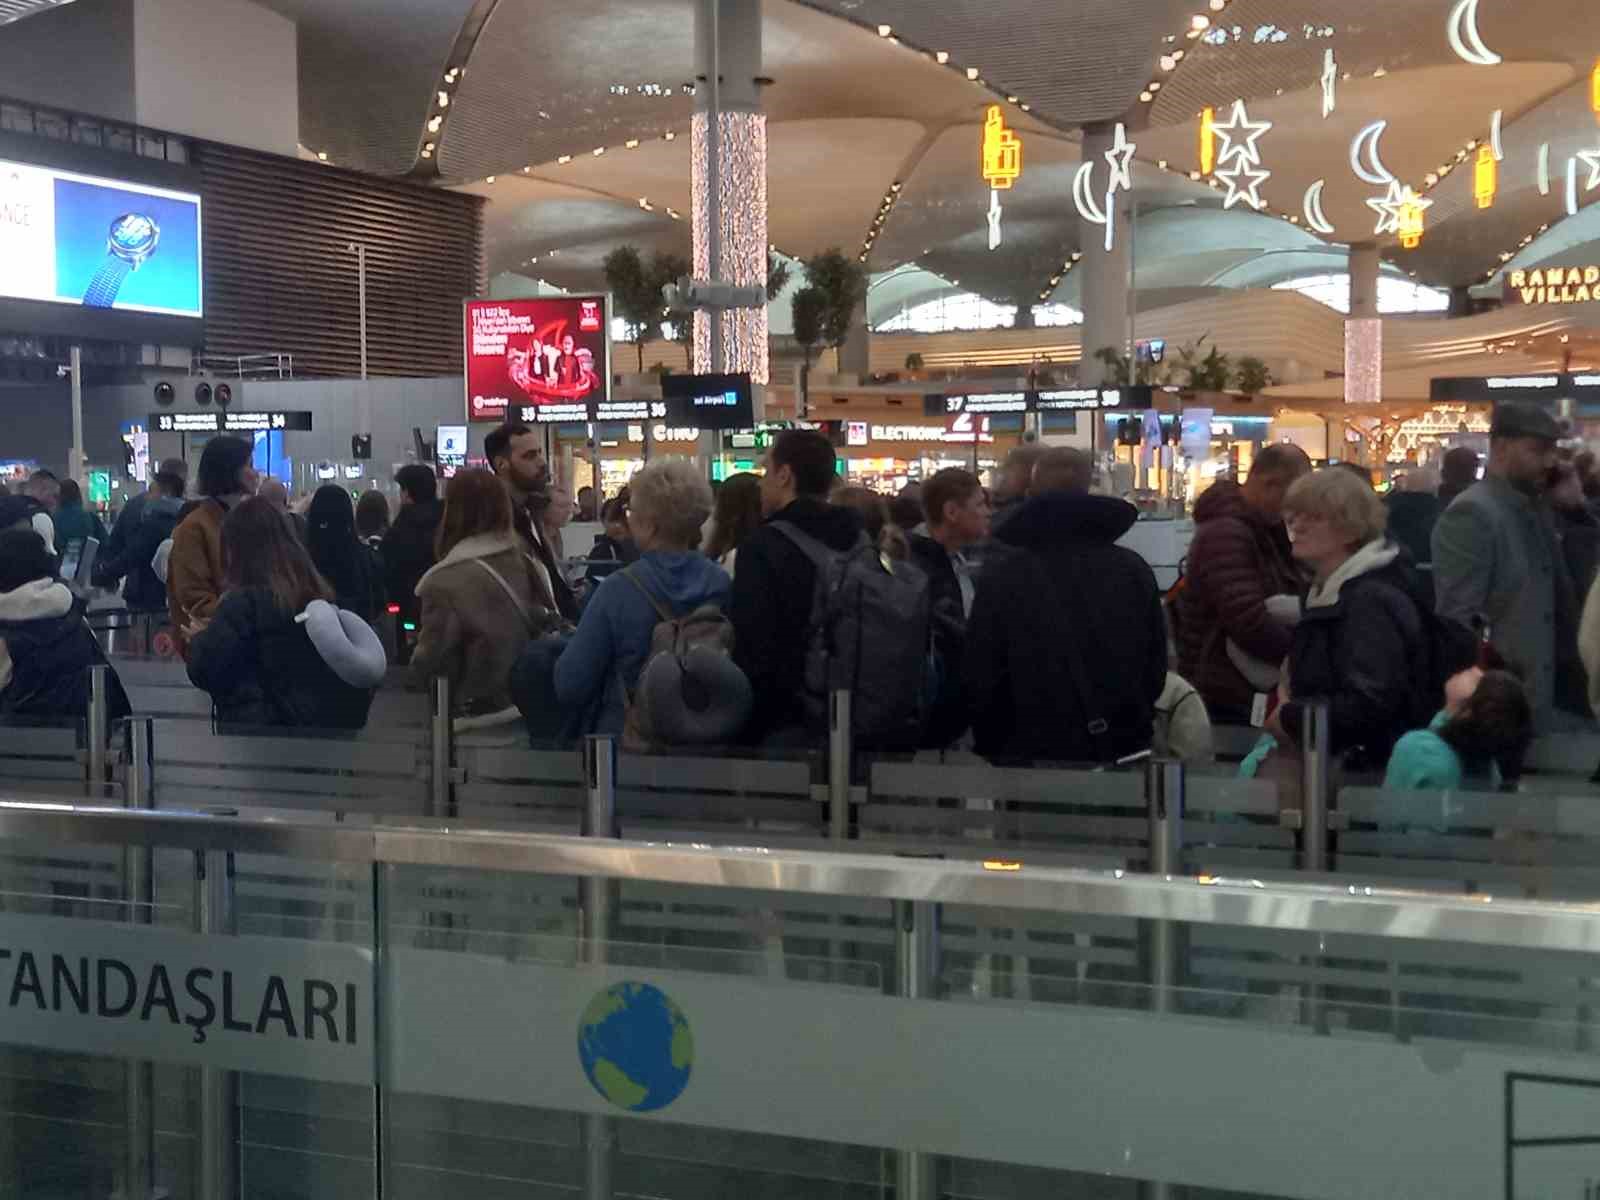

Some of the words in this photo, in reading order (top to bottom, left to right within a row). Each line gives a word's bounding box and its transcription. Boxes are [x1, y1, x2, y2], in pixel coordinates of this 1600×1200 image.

[0, 203, 32, 227] NCE
[1511, 265, 1600, 288] RAMAD
[946, 396, 964, 412] 37
[0, 948, 357, 1045] ANDAŞLARI
